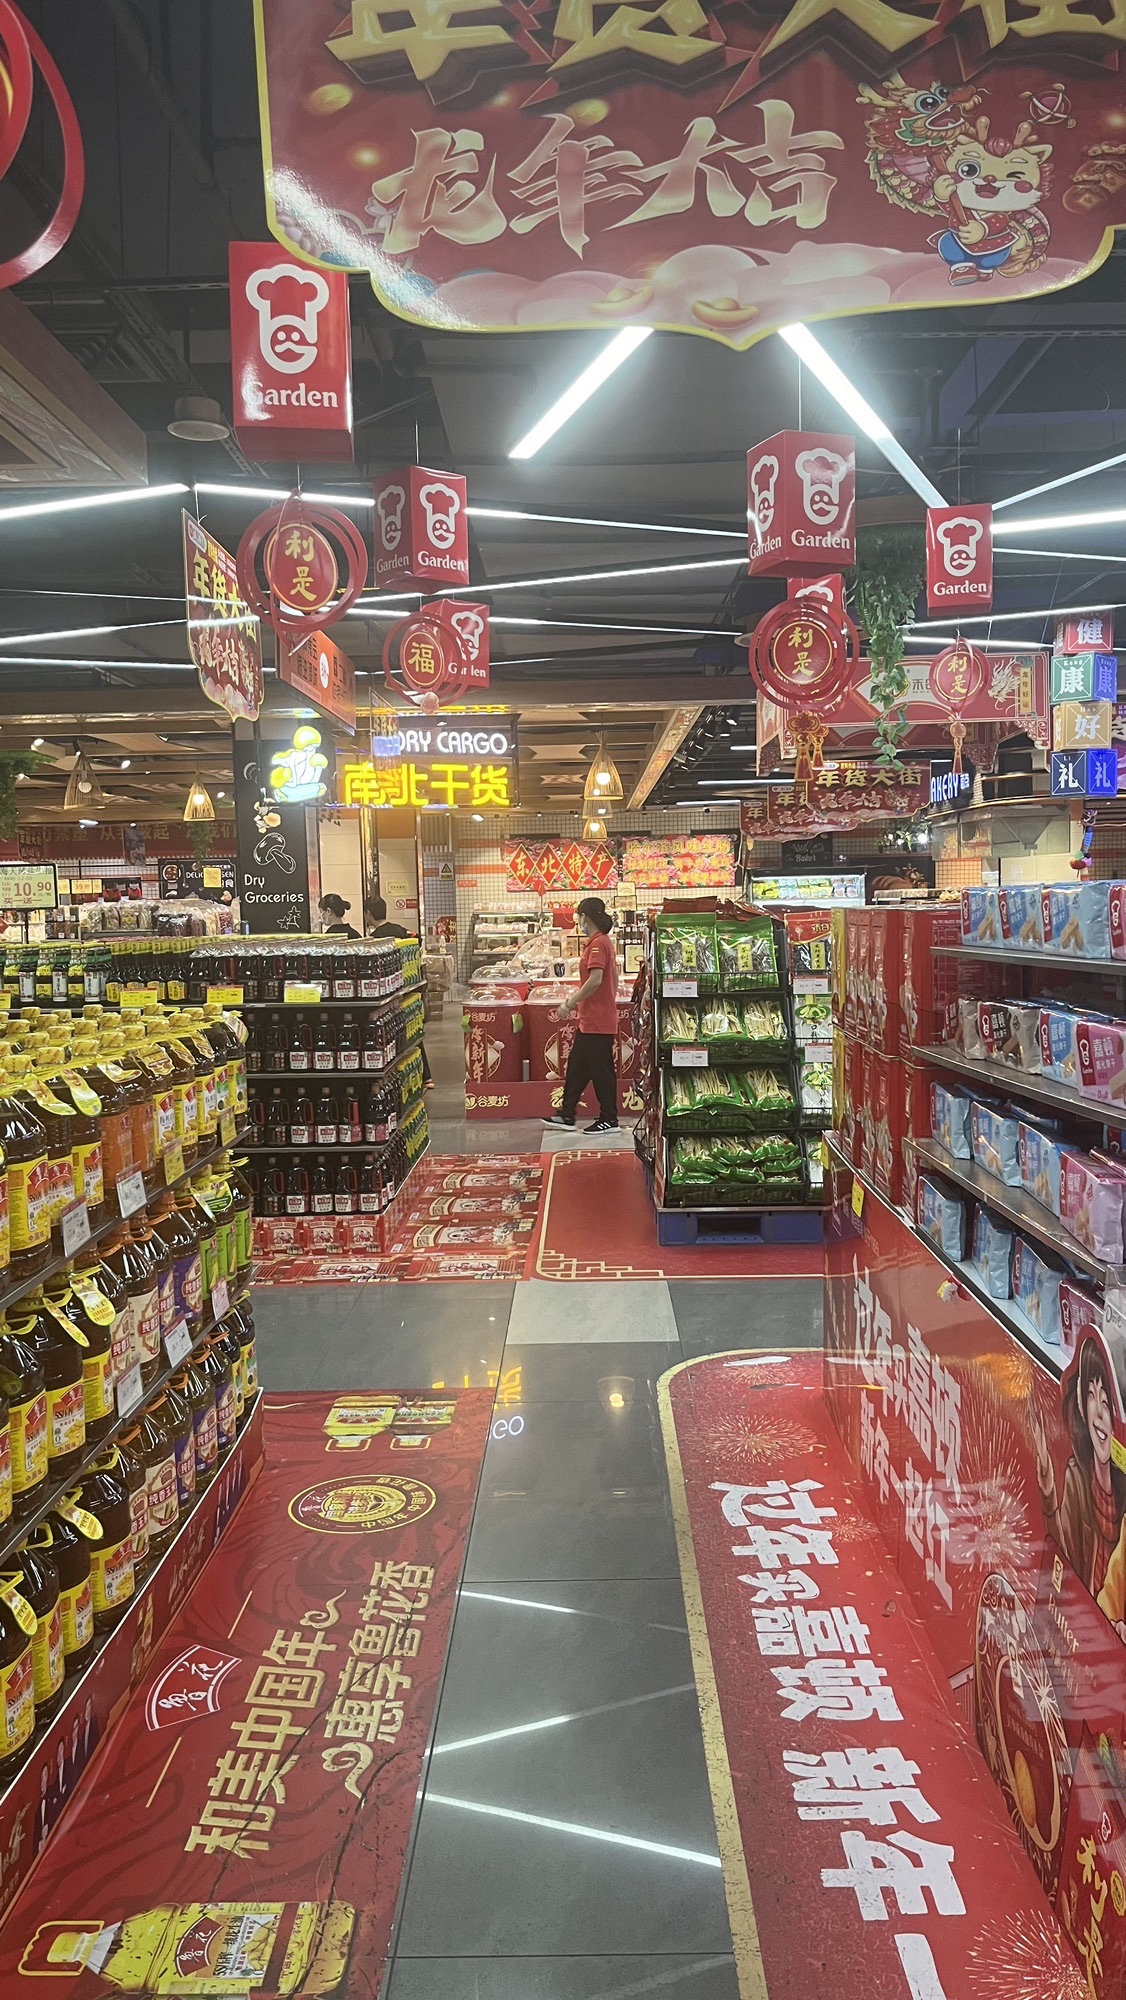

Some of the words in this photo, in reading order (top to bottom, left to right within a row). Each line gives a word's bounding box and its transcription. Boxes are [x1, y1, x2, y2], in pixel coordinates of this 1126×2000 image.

[372, 100, 844, 260] 龙年大吉
[242, 381, 339, 408] Garden
[750, 536, 782, 560] Garden
[791, 529, 851, 550] Garden
[285, 530, 318, 602] 利是
[376, 554, 410, 575] Garden
[417, 551, 465, 573] Garden
[933, 580, 988, 597] Garden
[1077, 619, 1103, 645] 健
[407, 641, 434, 675] 福
[787, 627, 814, 676] 利是
[947, 656, 968, 694] 利是
[1060, 666, 1085, 695] 康
[1098, 666, 1113, 693] 康
[1074, 714, 1101, 740] 好
[436, 732, 508, 755] CARGO
[344, 762, 510, 806] 南北干货
[815, 769, 922, 788] 年货大街
[930, 772, 959, 803] AKERY
[1059, 763, 1079, 789] 礼
[1094, 761, 1111, 788] 礼
[627, 839, 731, 855] 哈尔滨风味红肠
[513, 852, 609, 878] 东北特产
[244, 874, 266, 889] Dry
[244, 890, 305, 905] Groceries
[471, 1011, 496, 1022] 谷麦坊
[1093, 1036, 1115, 1058] 嘉顿
[477, 1095, 508, 1107] 谷麦坊
[406, 1490, 428, 1512] 中国味
[708, 1477, 905, 1722] 过年买嘉顿
[323, 1560, 435, 1744] 惠享鲁花香
[158, 1660, 224, 1712] 鲁花
[184, 1629, 339, 1860] 和美中国年
